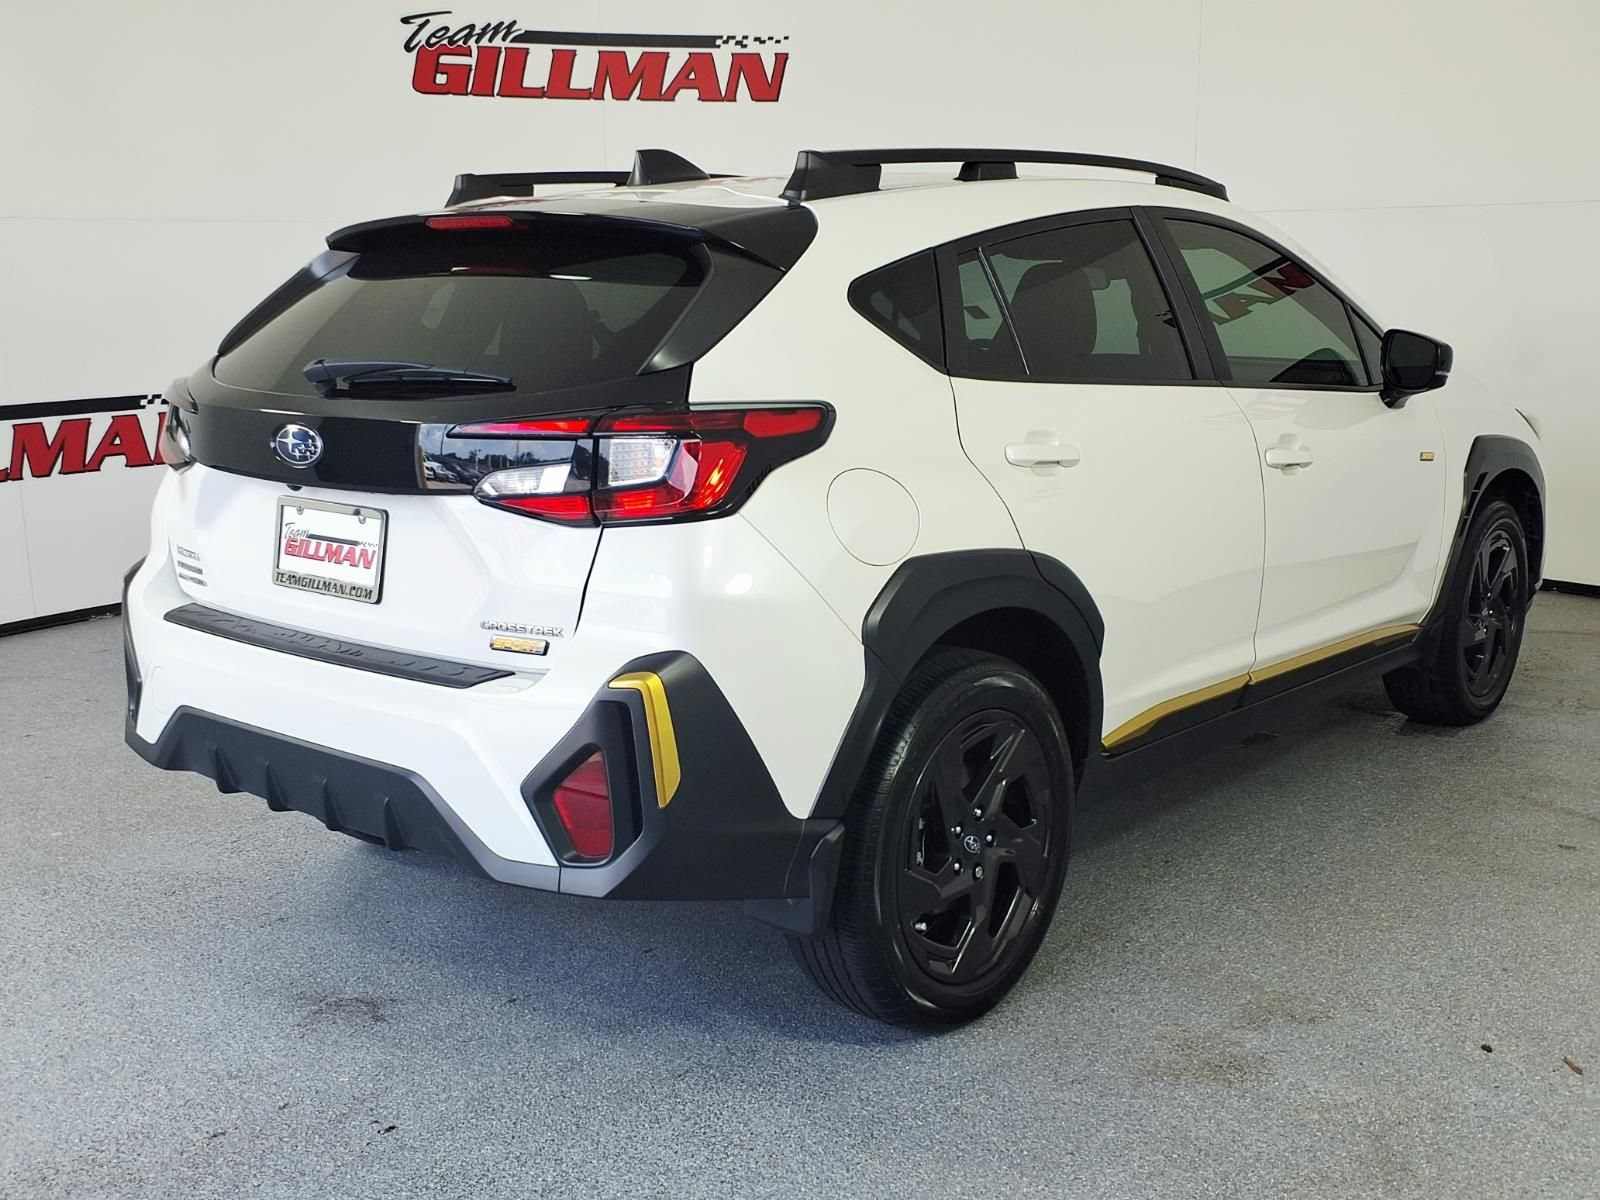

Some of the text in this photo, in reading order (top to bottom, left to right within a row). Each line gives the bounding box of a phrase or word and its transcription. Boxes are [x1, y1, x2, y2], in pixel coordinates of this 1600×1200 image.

[400, 10, 526, 53] Team
[412, 44, 790, 103] GILLMAN
[284, 521, 310, 540] Team
[284, 537, 377, 570] GILLMAN
[275, 571, 374, 600] TEAMGILLMAN.COM
[480, 620, 565, 638] CROSSTREK
